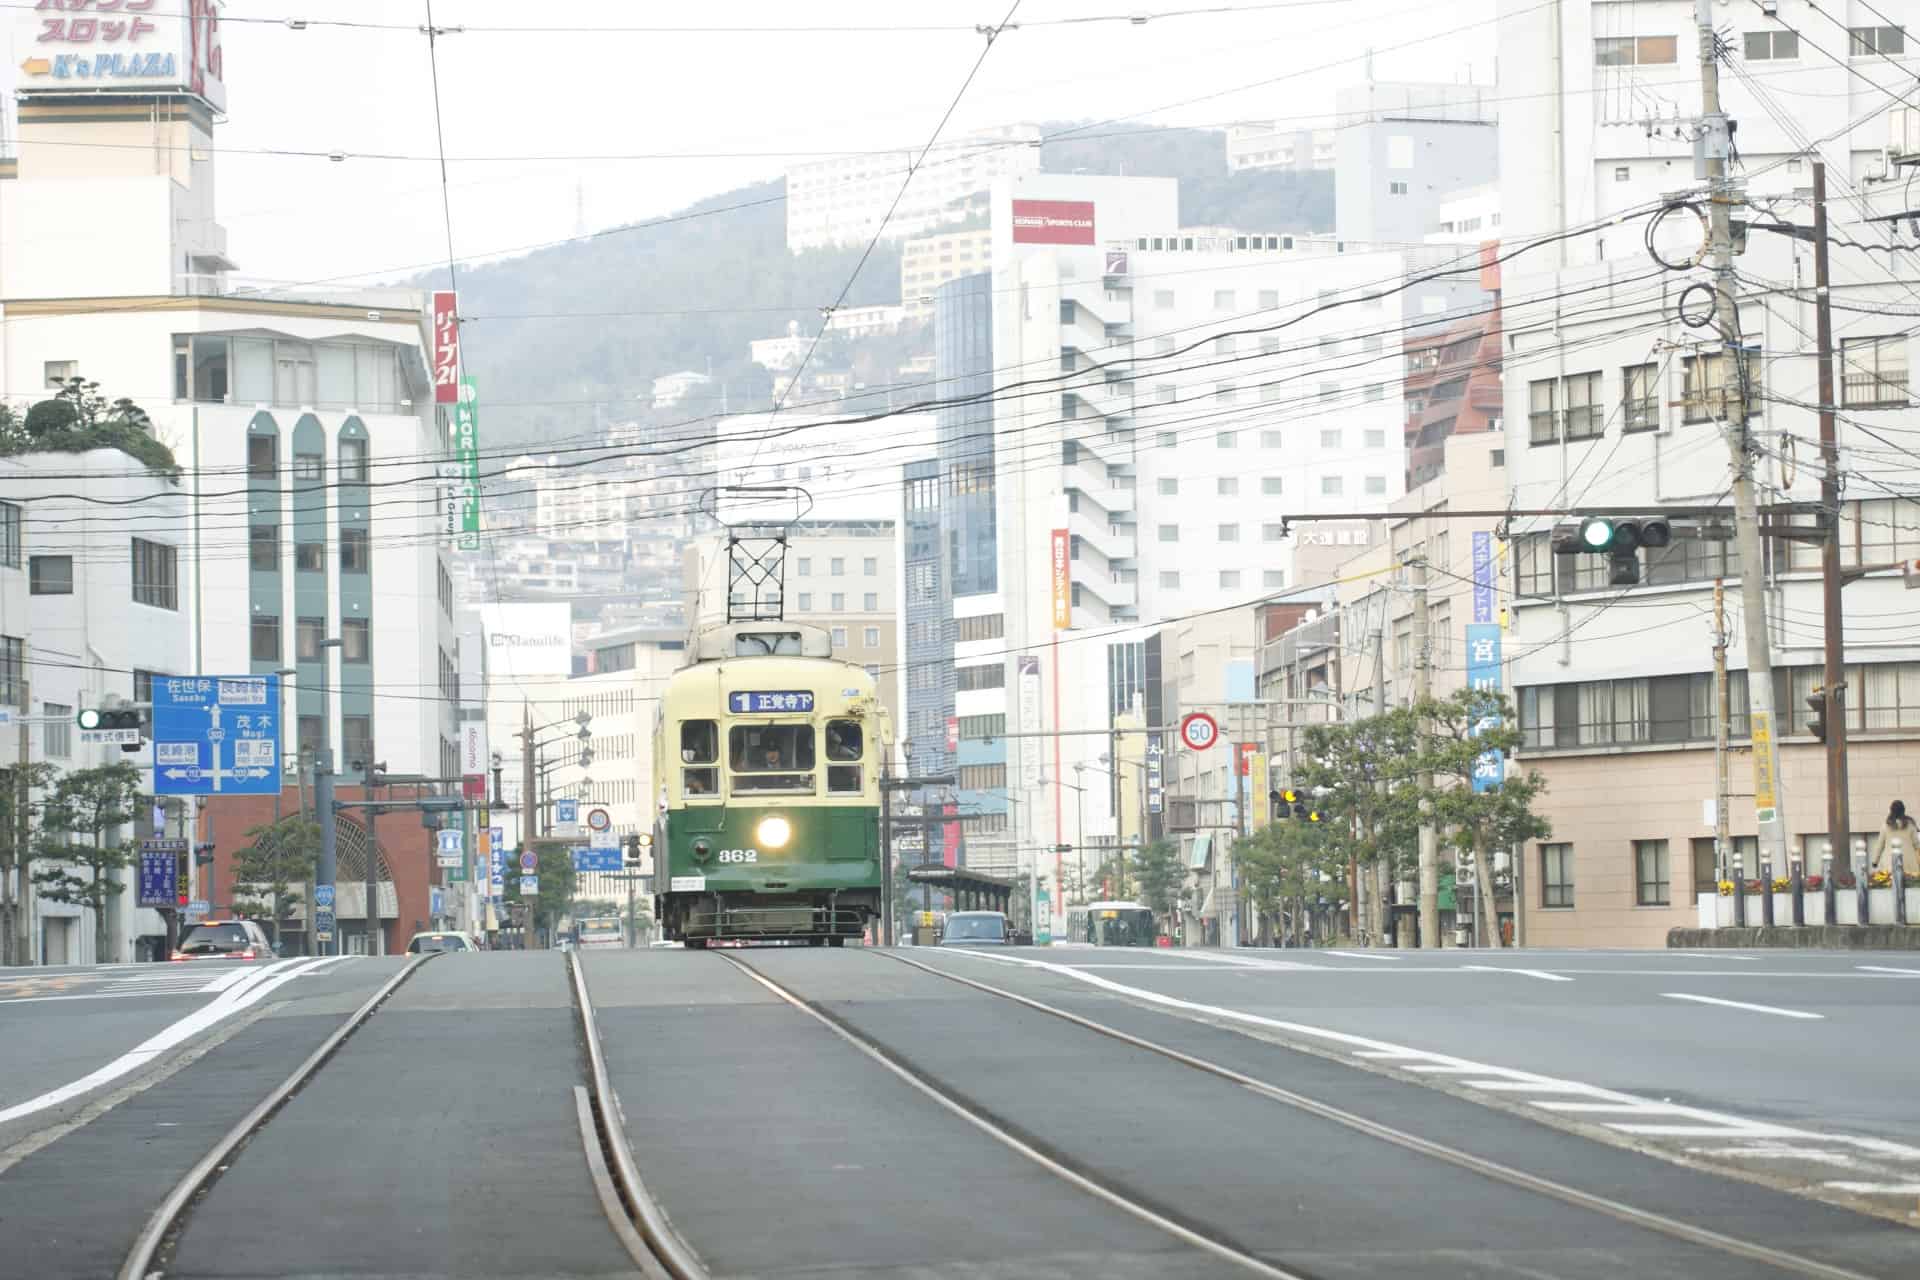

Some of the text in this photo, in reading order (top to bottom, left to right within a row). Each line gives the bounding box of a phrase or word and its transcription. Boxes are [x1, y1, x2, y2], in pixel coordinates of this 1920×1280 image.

[36, 16, 156, 42] スロット
[52, 53, 176, 79] K's PLAZA
[1075, 219, 1093, 227] CLUB
[436, 310, 457, 384] リーブ21
[503, 633, 566, 648] Manulife
[168, 679, 212, 694] 佐世保
[735, 692, 751, 712] 1
[1472, 637, 1499, 778] 宮川院
[235, 713, 272, 728] 茂木
[1189, 723, 1210, 741] 50
